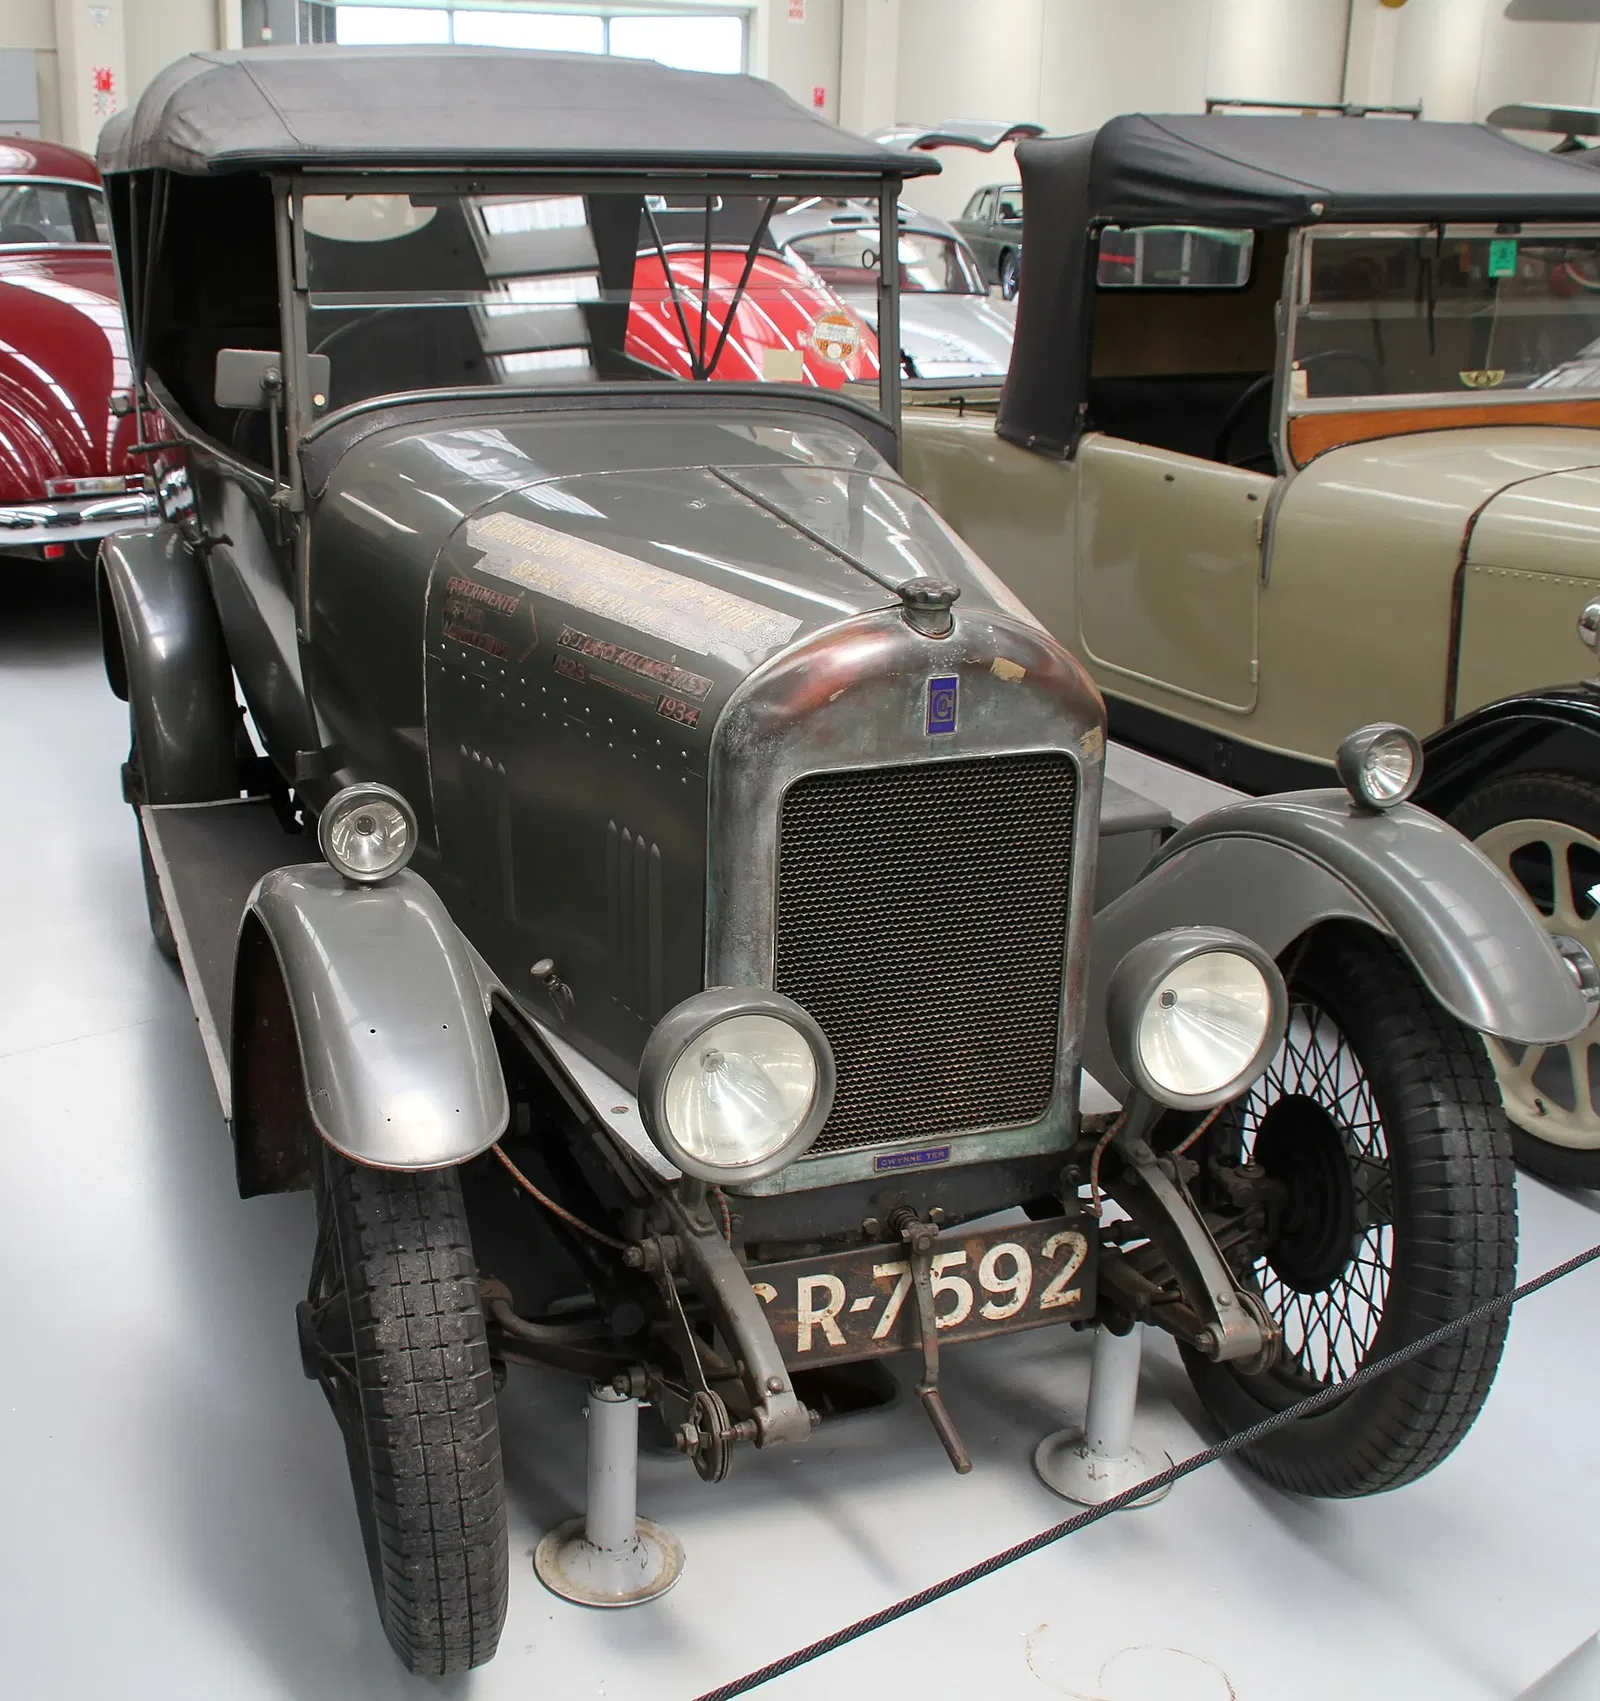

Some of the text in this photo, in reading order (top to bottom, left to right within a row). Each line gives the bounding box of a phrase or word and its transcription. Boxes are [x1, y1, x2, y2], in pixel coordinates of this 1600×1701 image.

[553, 654, 700, 727] 1923 1934
[881, 1155, 921, 1166] GWYNNE
[751, 1230, 1089, 1353] R-7592
